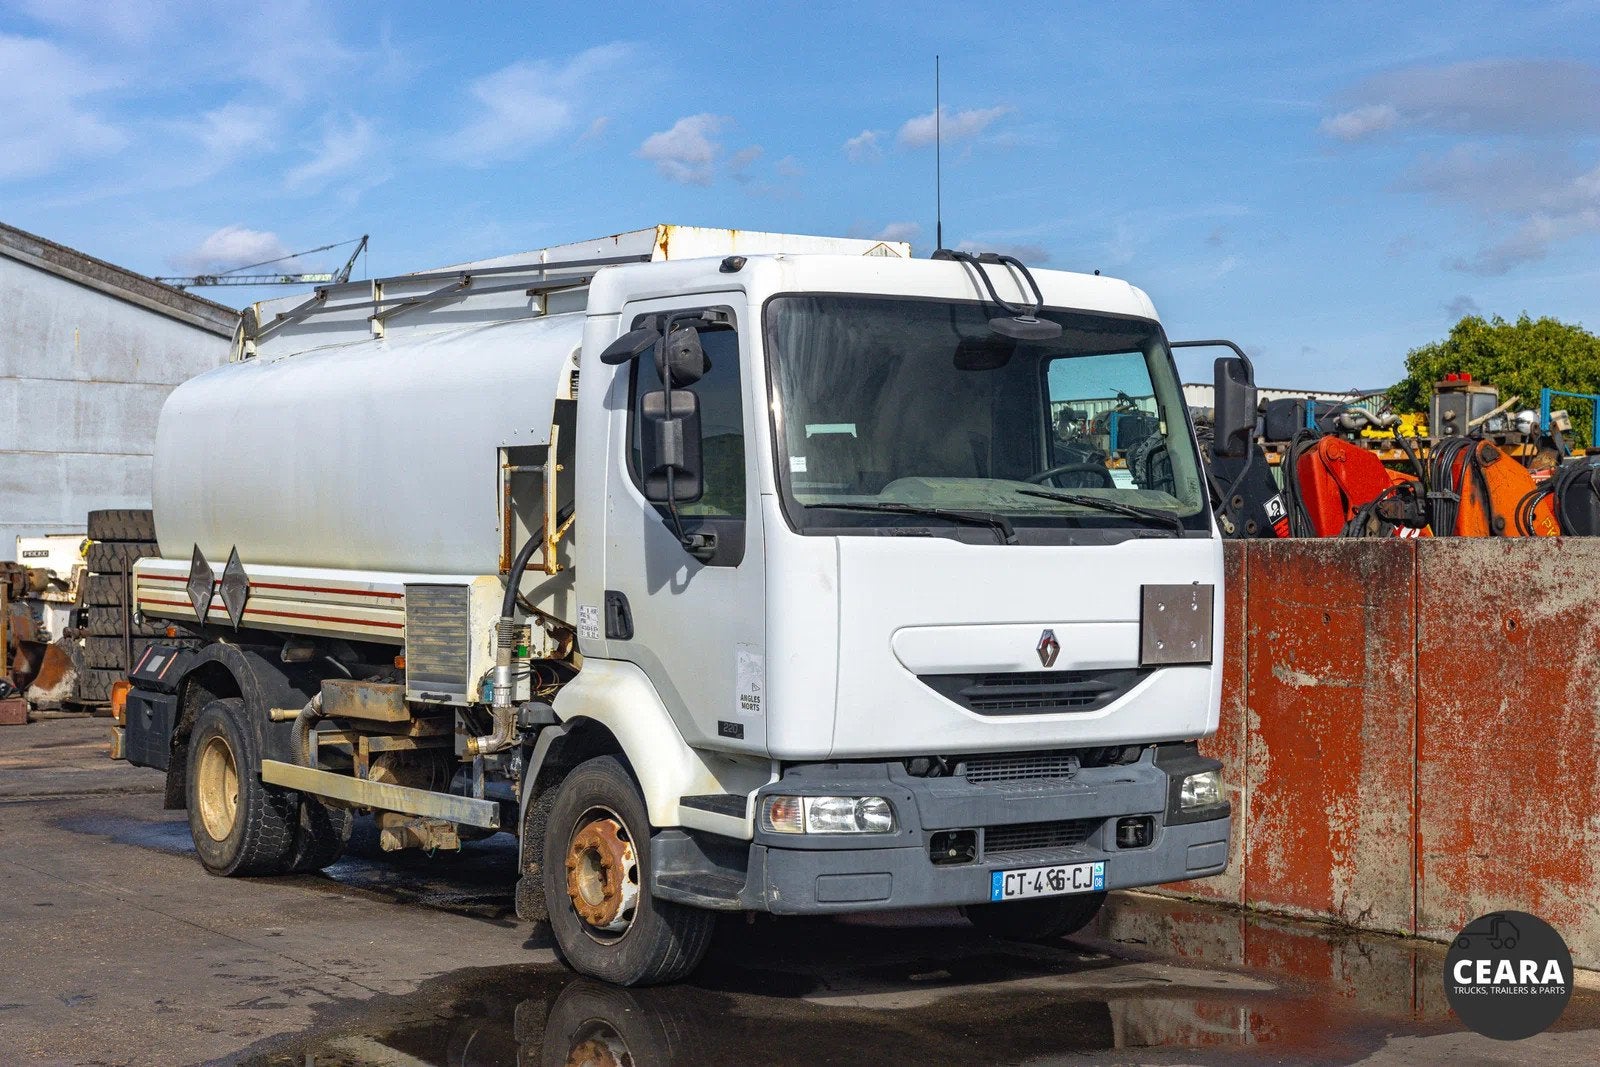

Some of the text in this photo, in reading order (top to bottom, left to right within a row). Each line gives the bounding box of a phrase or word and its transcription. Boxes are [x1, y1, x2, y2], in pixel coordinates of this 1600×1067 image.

[740, 694, 760, 703] ANGLES
[741, 702, 760, 712] MORTS
[723, 723, 738, 734] 220
